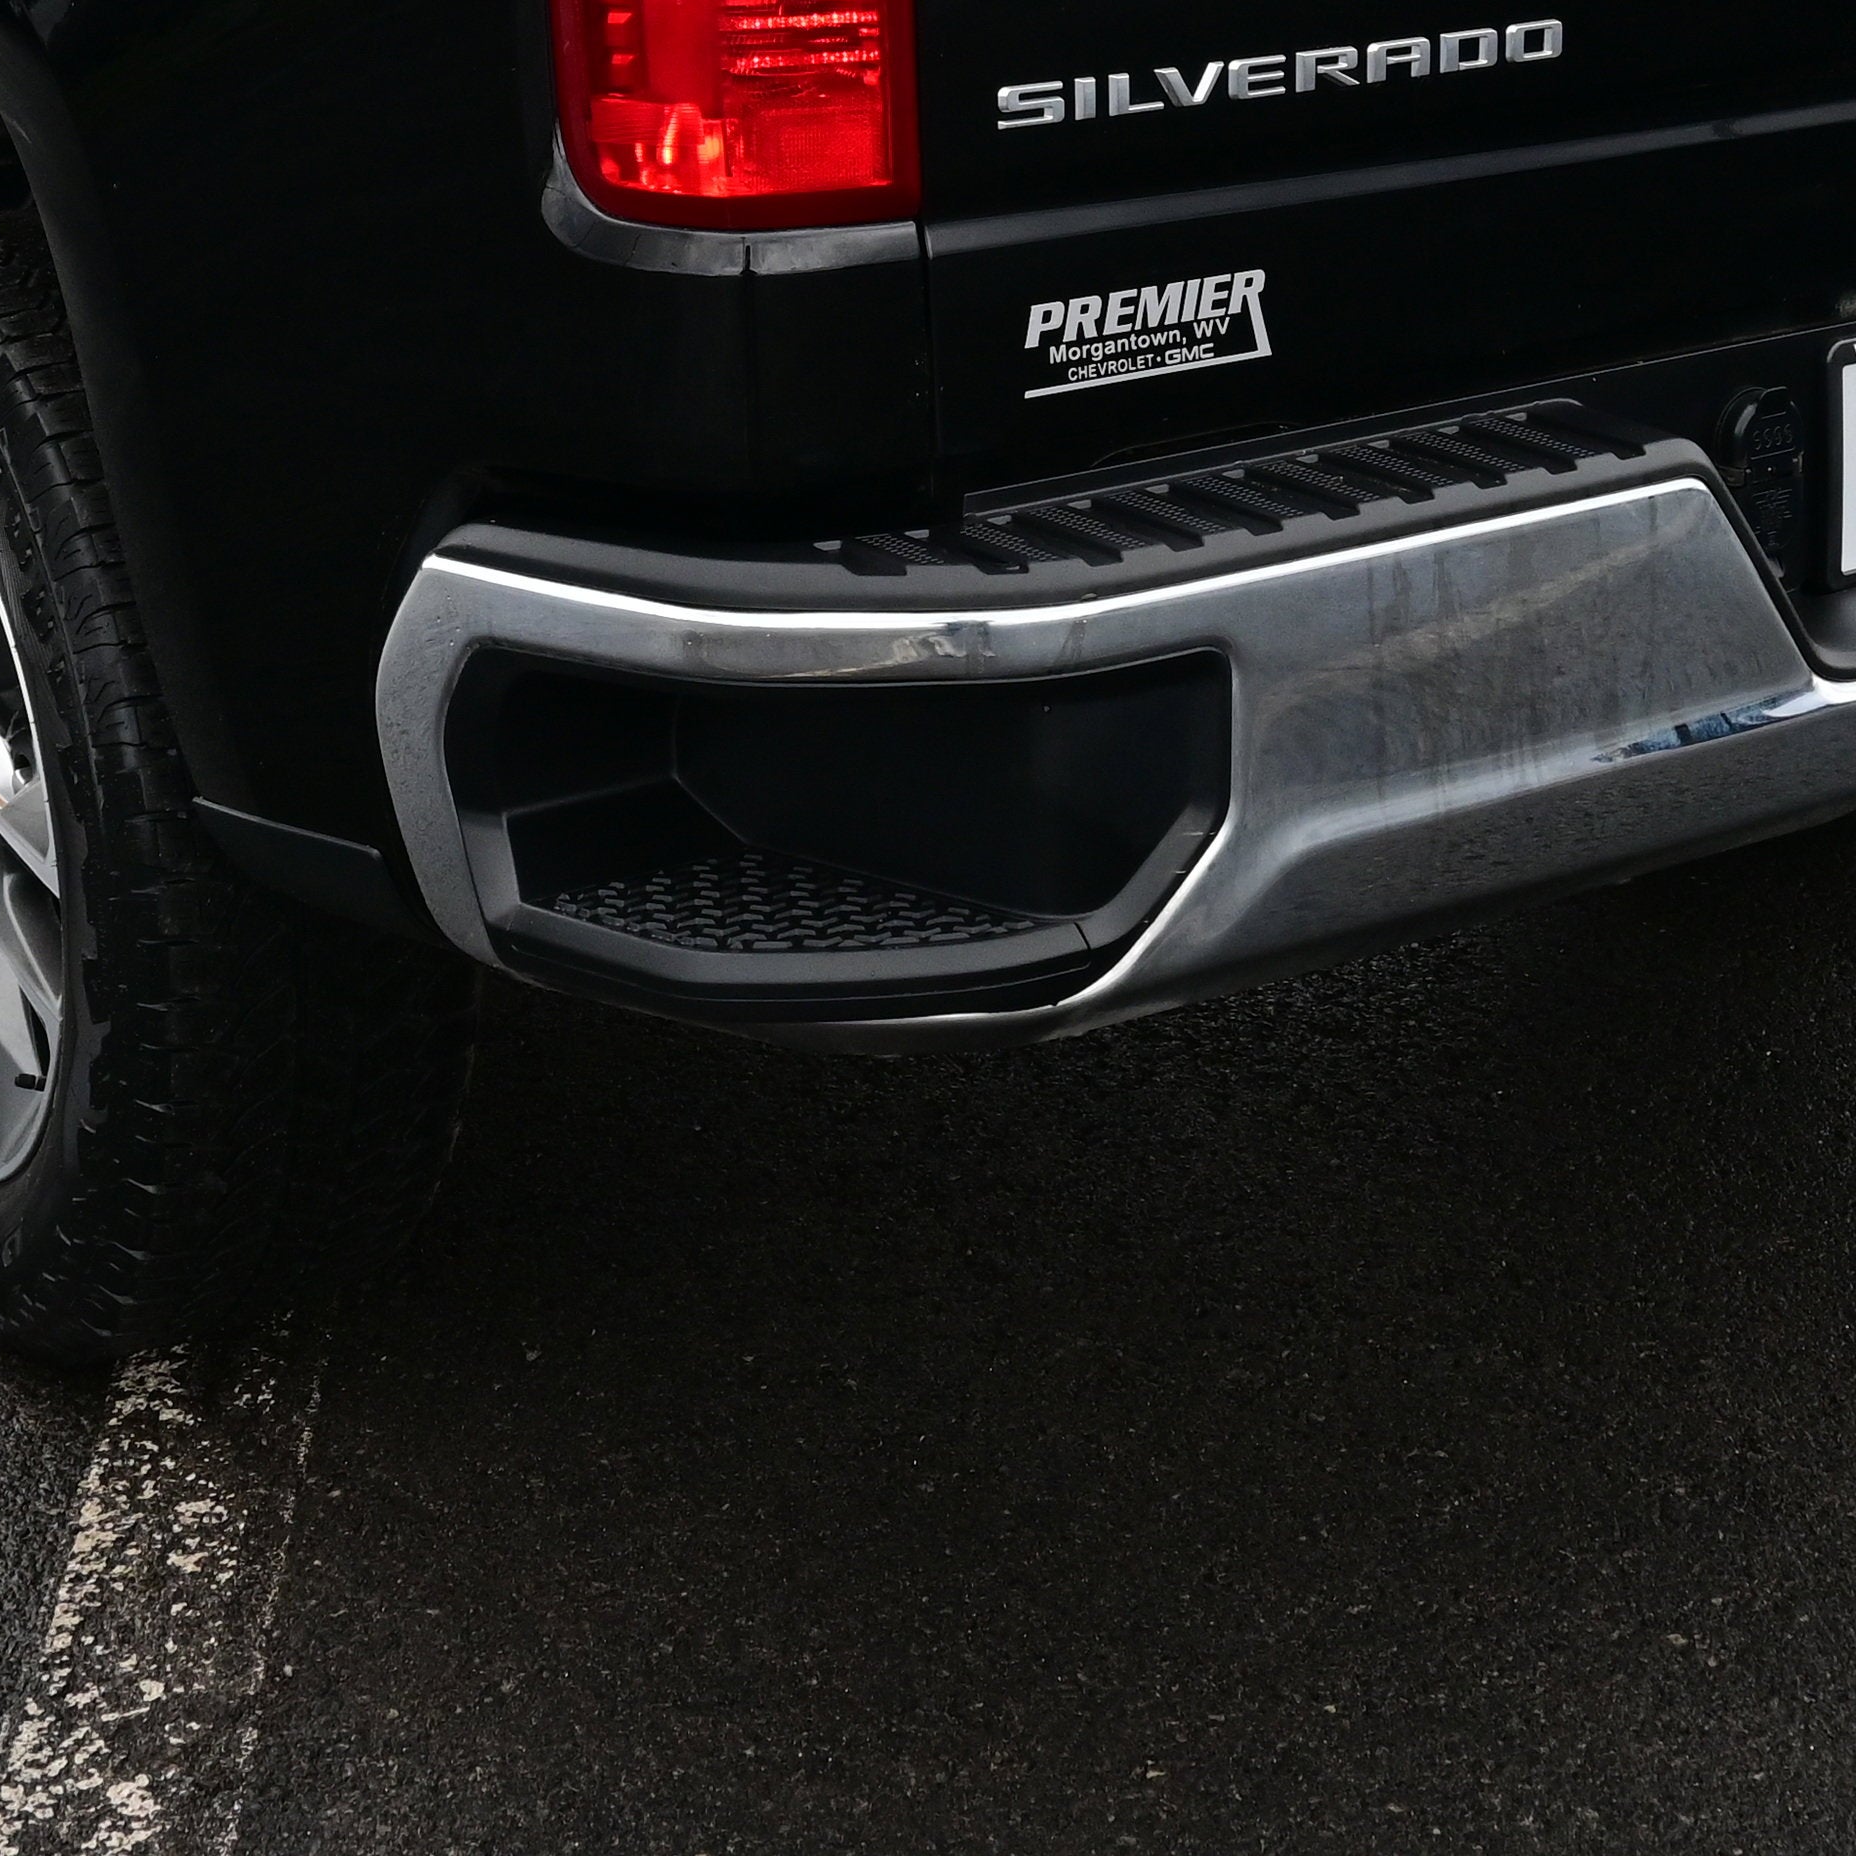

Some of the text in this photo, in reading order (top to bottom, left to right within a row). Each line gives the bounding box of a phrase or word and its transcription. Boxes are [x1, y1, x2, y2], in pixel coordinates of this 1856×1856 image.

[997, 19, 1563, 129] SILVERADO
[1024, 269, 1268, 350] PREMIER
[1049, 316, 1231, 364] Morgantown, WV
[1164, 342, 1215, 366] GMC
